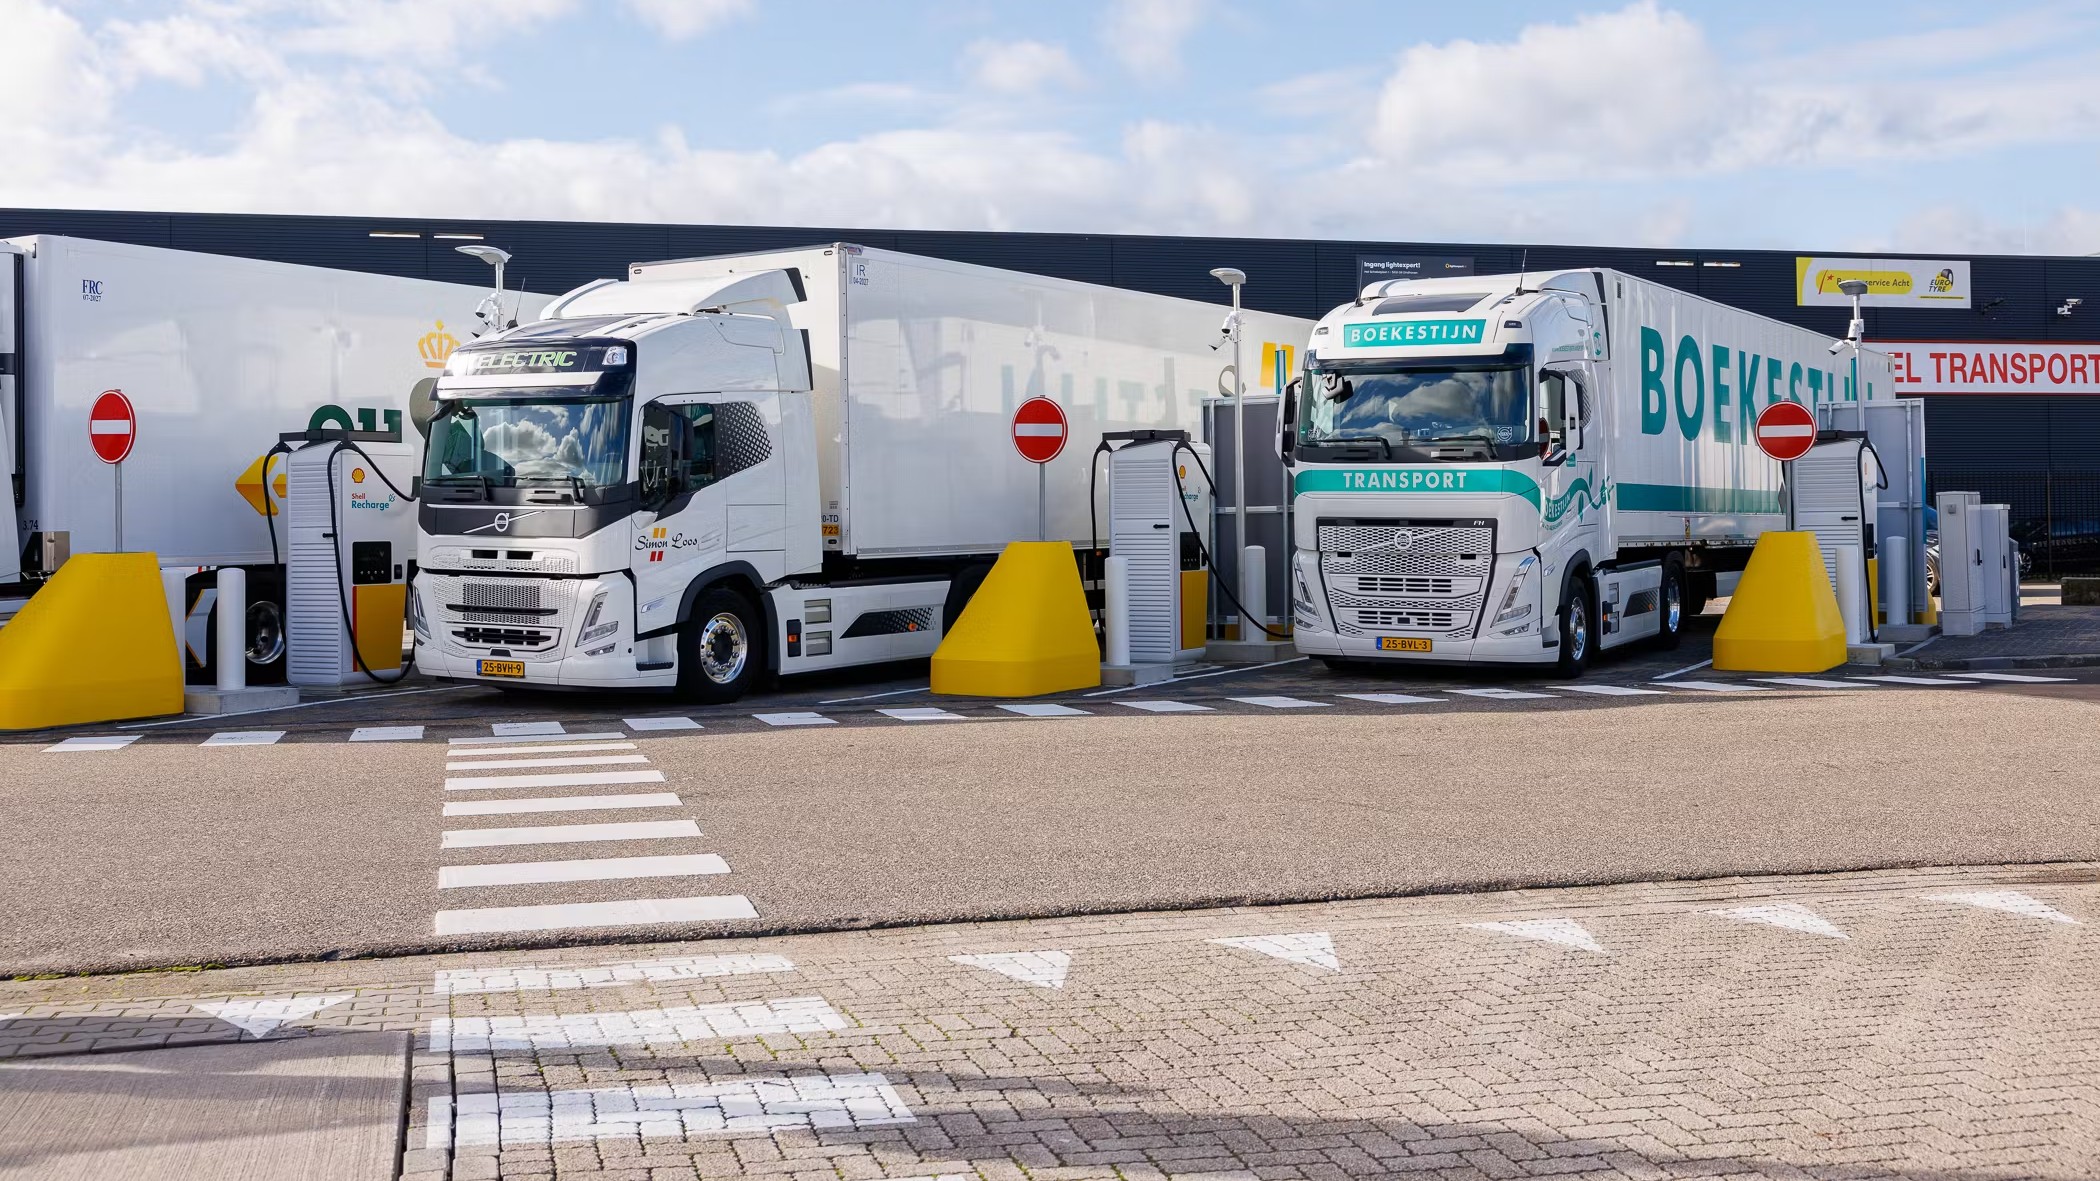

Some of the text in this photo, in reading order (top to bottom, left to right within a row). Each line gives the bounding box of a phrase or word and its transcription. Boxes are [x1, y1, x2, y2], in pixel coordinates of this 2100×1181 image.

[856, 264, 866, 276] IR
[82, 279, 103, 295] FRC
[1892, 278, 1910, 287] Acht
[1351, 325, 1476, 342] BOEKESTIJN
[478, 351, 577, 368] ELECTRIC
[1343, 472, 1467, 489] TRANSPORT
[351, 500, 390, 511] Recharge
[634, 532, 698, 551] Simon Loos
[1385, 639, 1428, 650] 25-BVL-3
[483, 661, 521, 673] 25-BVH-9
